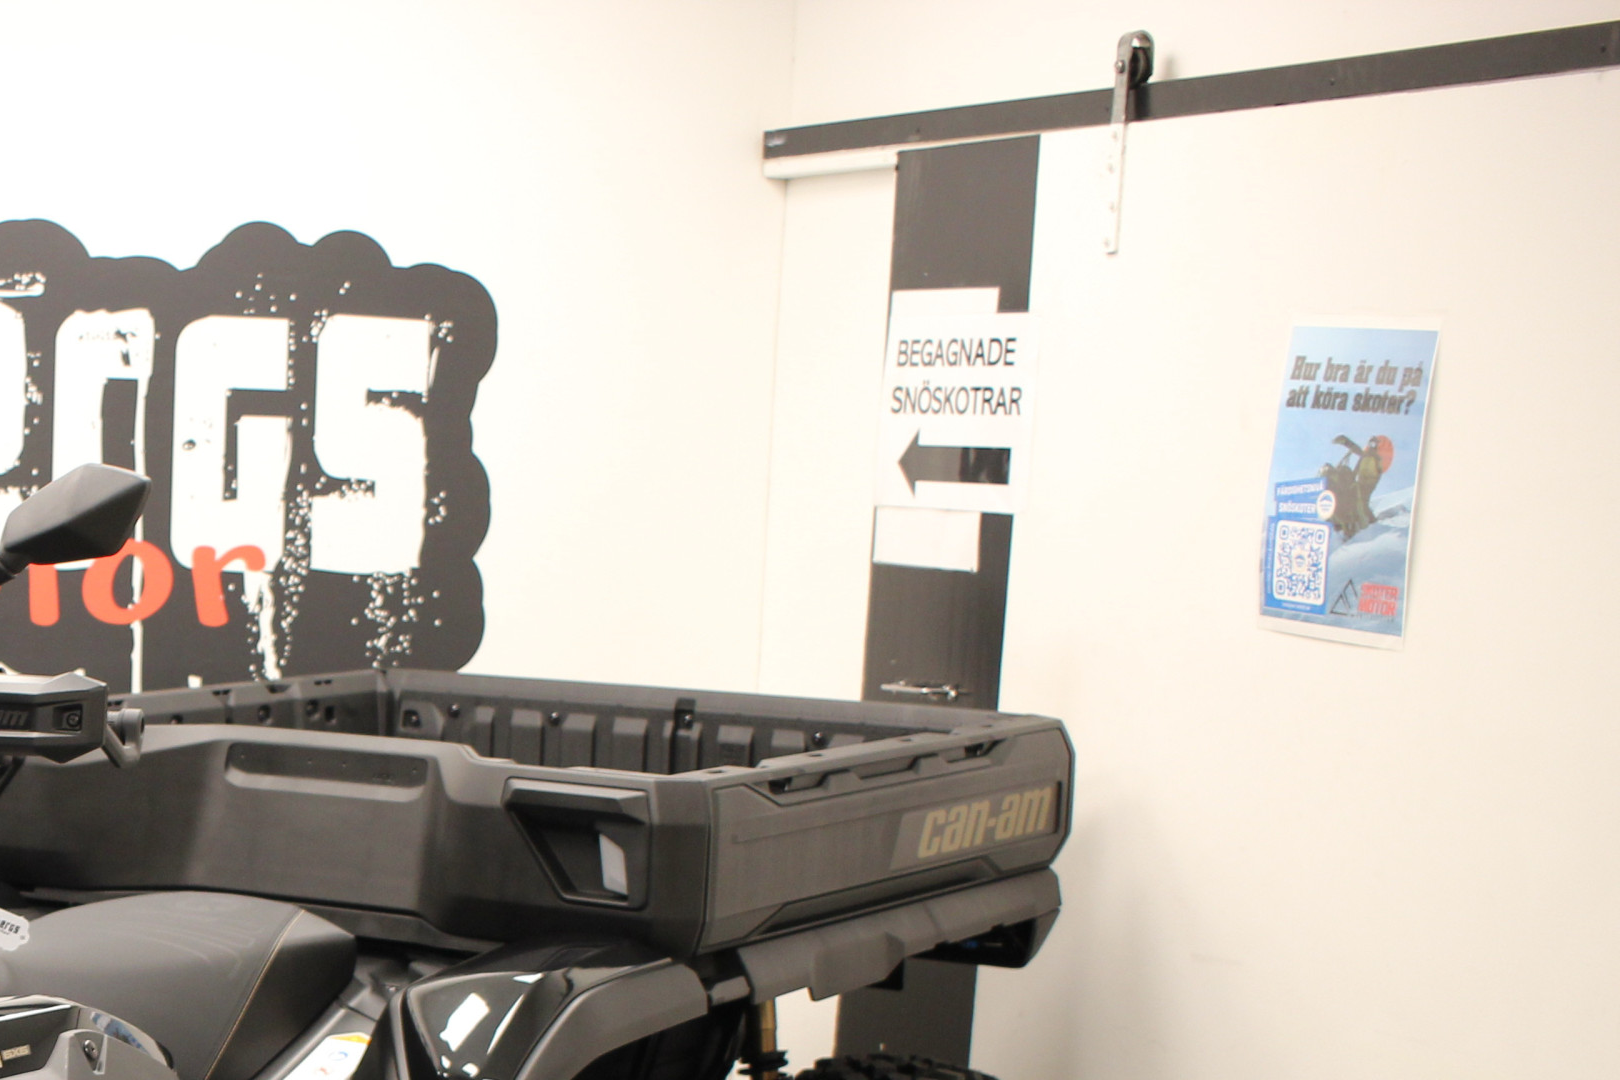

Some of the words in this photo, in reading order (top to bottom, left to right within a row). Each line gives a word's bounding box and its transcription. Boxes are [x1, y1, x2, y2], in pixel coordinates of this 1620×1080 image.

[896, 337, 1017, 367] BEGAGNADE
[1290, 355, 1321, 381] Hur
[1323, 357, 1351, 383] bra
[1354, 359, 1374, 384] är
[1375, 359, 1398, 385] du
[1398, 360, 1424, 392] på
[891, 379, 1022, 415] SNÖSKOTRAR
[1286, 385, 1309, 408] att
[1311, 385, 1349, 410] köra
[1351, 387, 1417, 415] skoter?
[916, 786, 1054, 859] can-am
